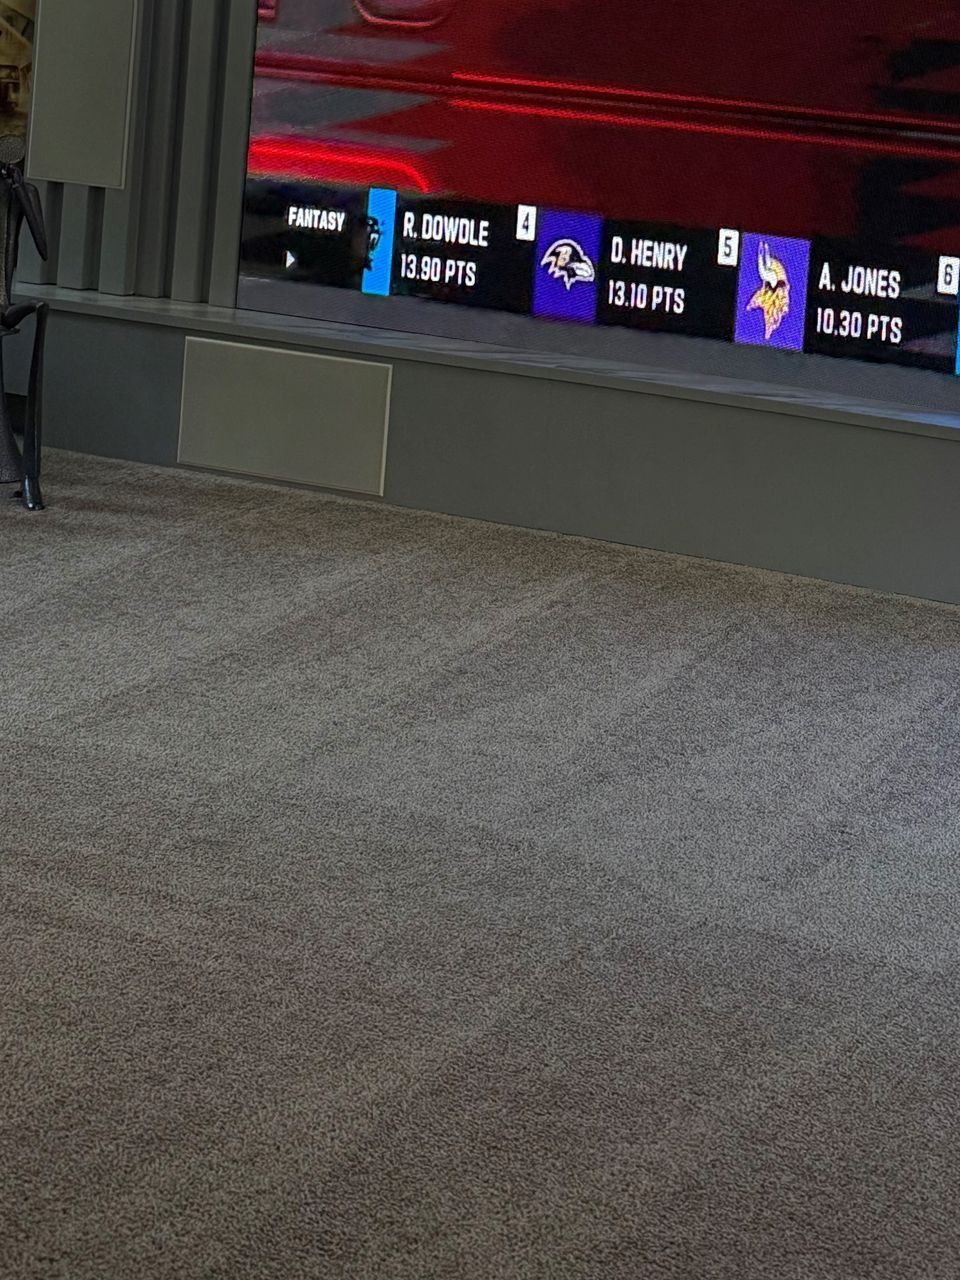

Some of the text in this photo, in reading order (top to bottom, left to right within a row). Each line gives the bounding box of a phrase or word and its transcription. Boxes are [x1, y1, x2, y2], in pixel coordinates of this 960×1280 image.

[287, 206, 347, 233] FANTASY
[402, 211, 490, 248] R. DOWDLE
[611, 236, 687, 273] D. HENRY
[723, 236, 733, 258] 5
[400, 253, 477, 287] 13.90 PTS
[818, 262, 901, 300] A. JONES
[943, 263, 953, 286] 6
[608, 280, 686, 315] 13.10 PTS
[816, 307, 903, 345] 10.30 PTS
